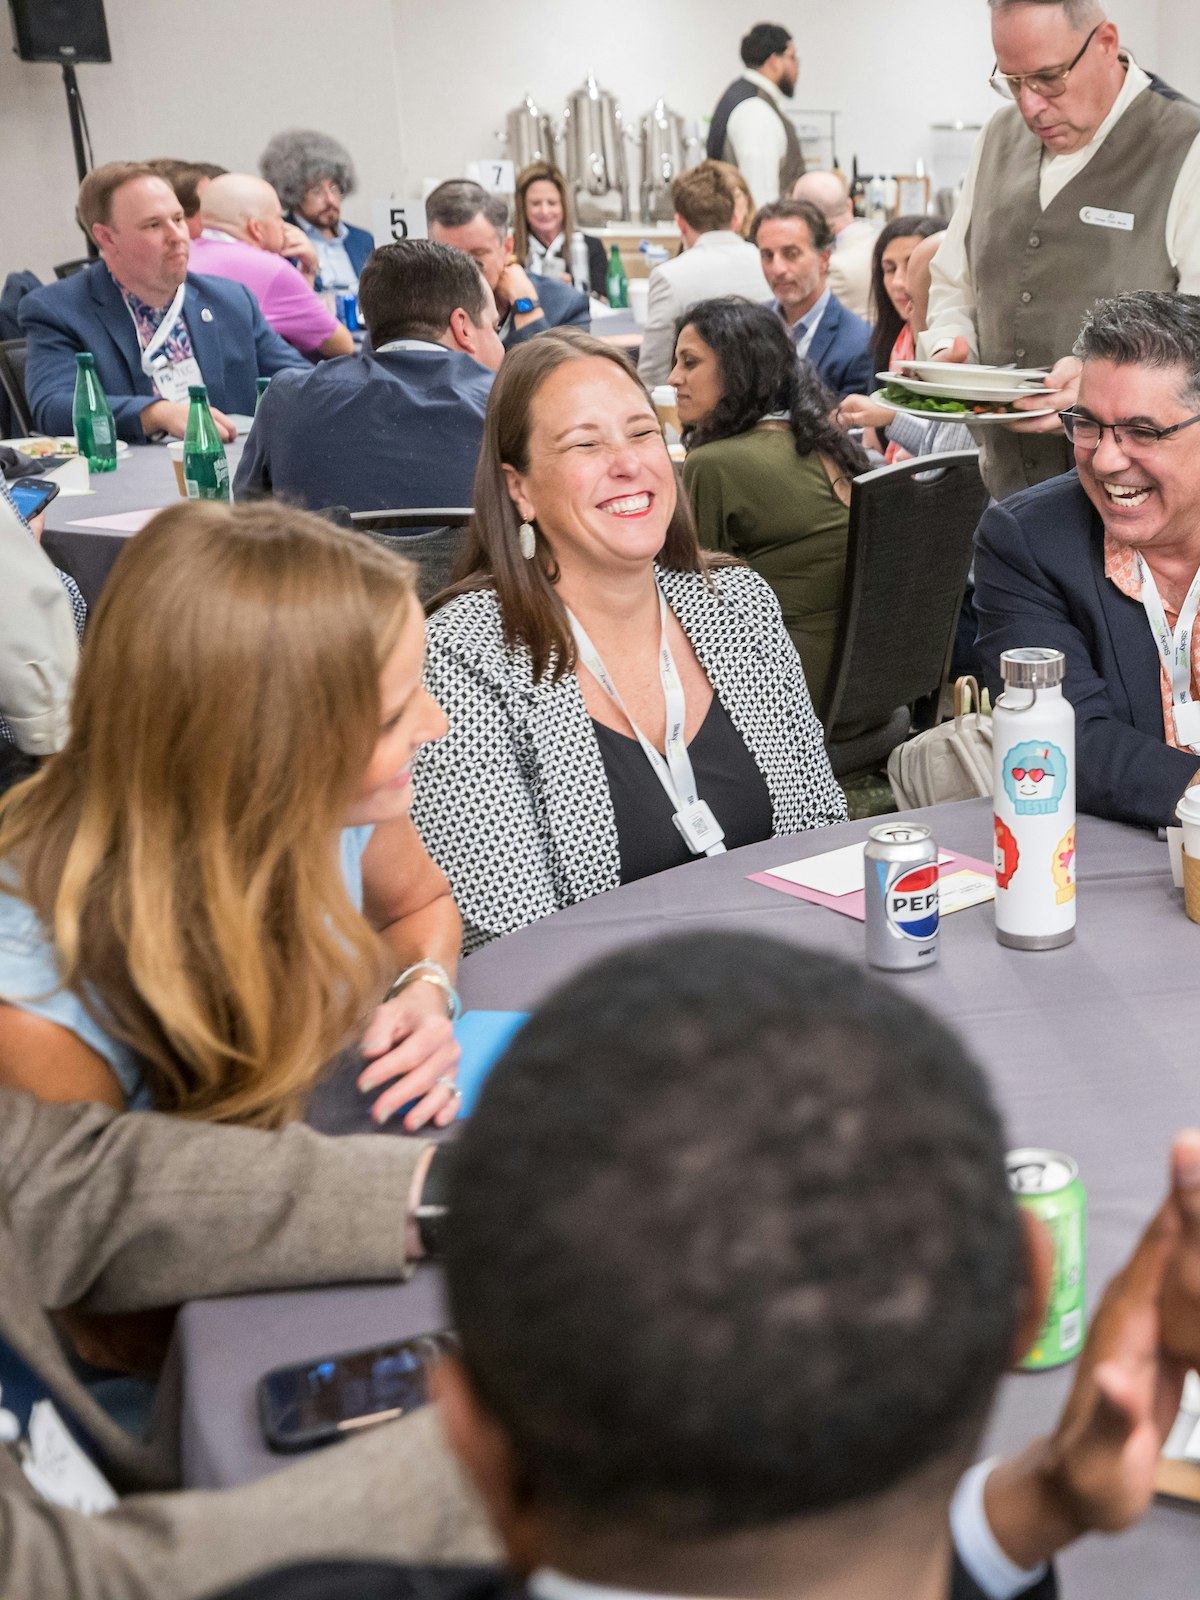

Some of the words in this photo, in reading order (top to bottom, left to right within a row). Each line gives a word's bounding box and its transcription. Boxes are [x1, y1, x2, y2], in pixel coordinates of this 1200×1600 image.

[492, 166, 502, 185] 7
[390, 208, 408, 240] 5
[1159, 634, 1171, 656] Sticky
[1016, 800, 1058, 814] BESTIE
